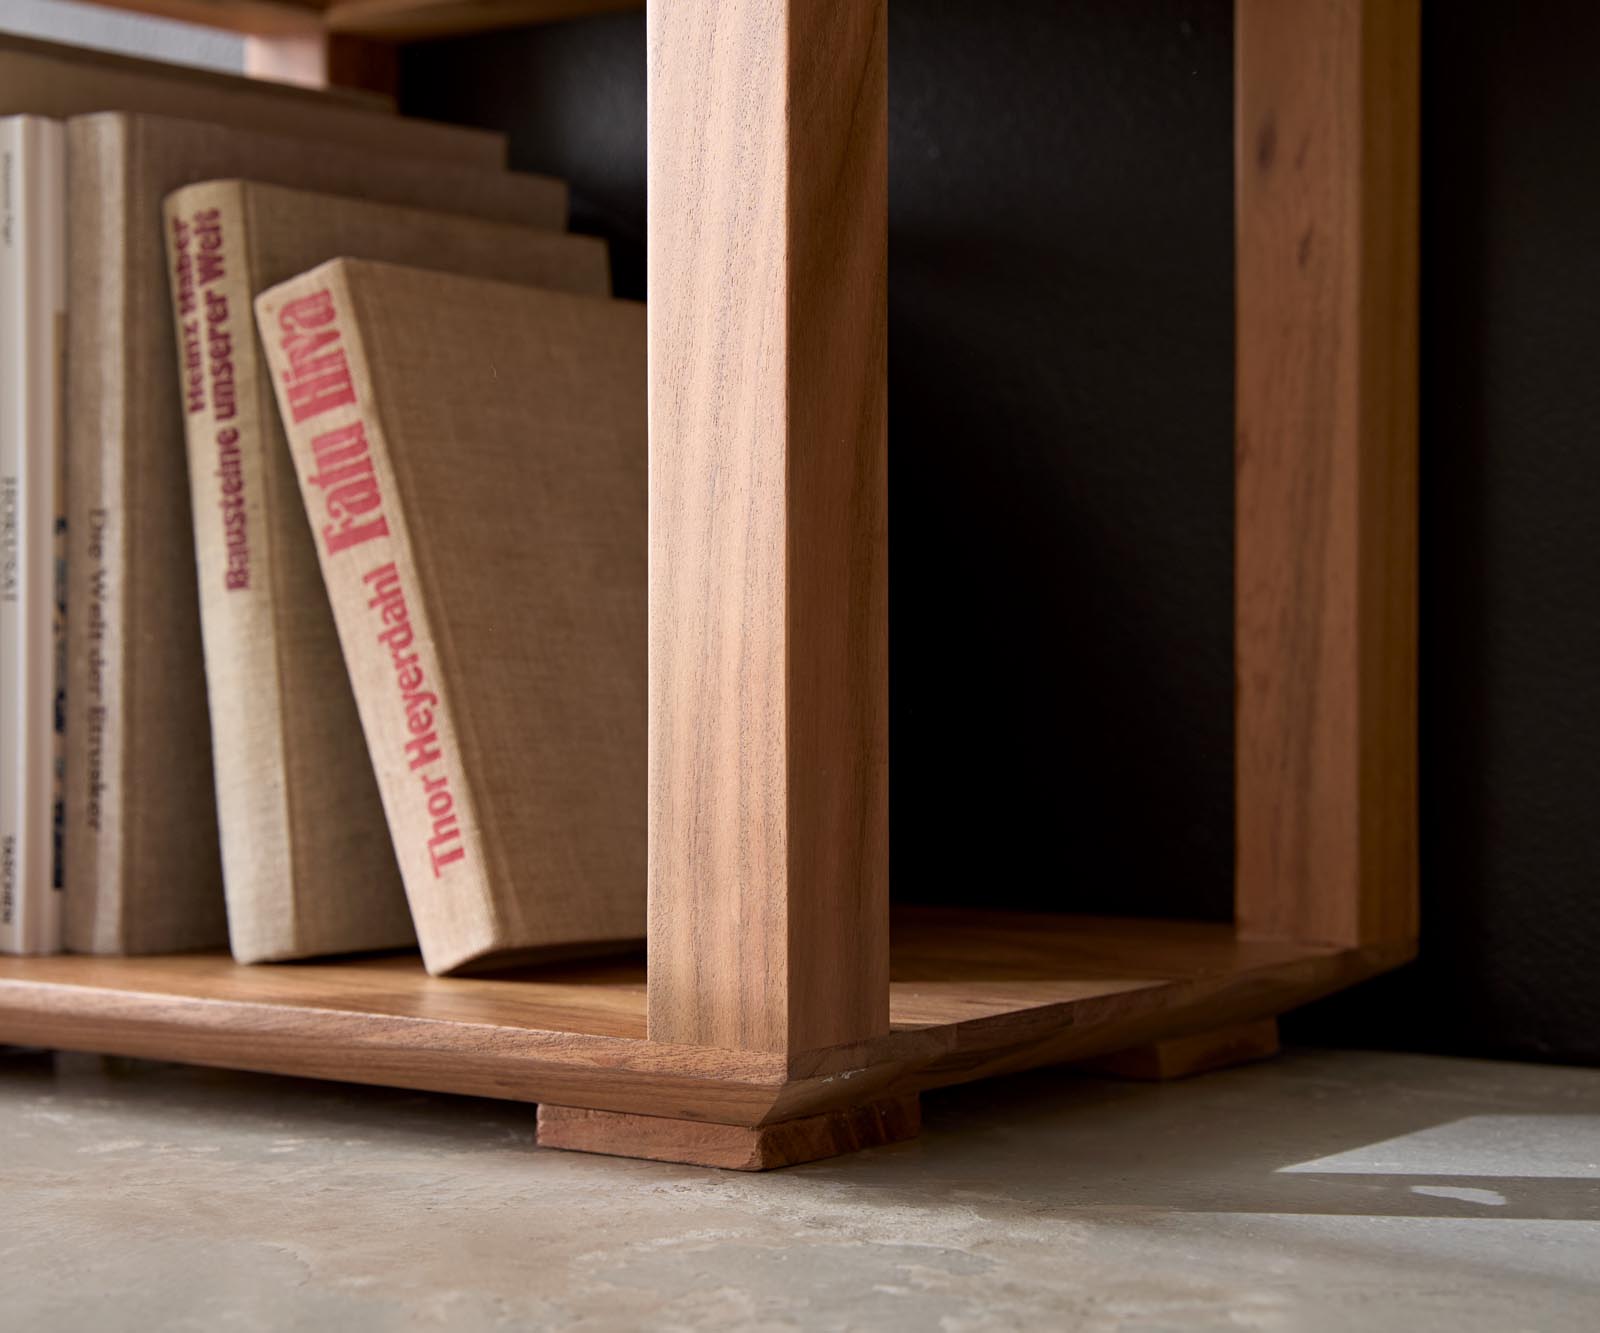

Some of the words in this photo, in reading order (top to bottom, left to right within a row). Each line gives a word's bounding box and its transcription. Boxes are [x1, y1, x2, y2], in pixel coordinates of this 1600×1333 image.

[174, 217, 197, 316] Haber
[195, 208, 225, 286] Welt
[183, 321, 207, 413] Heinz
[206, 290, 238, 421] unserer
[278, 288, 357, 424] Hiva
[88, 508, 106, 559] Die
[216, 427, 250, 591] Bausteine
[309, 421, 390, 555] Fatu
[90, 570, 107, 640] Welt
[87, 648, 106, 697] der
[362, 561, 442, 771] Heyerdahl
[87, 706, 107, 833] Etrusker
[421, 774, 465, 878] Thor
